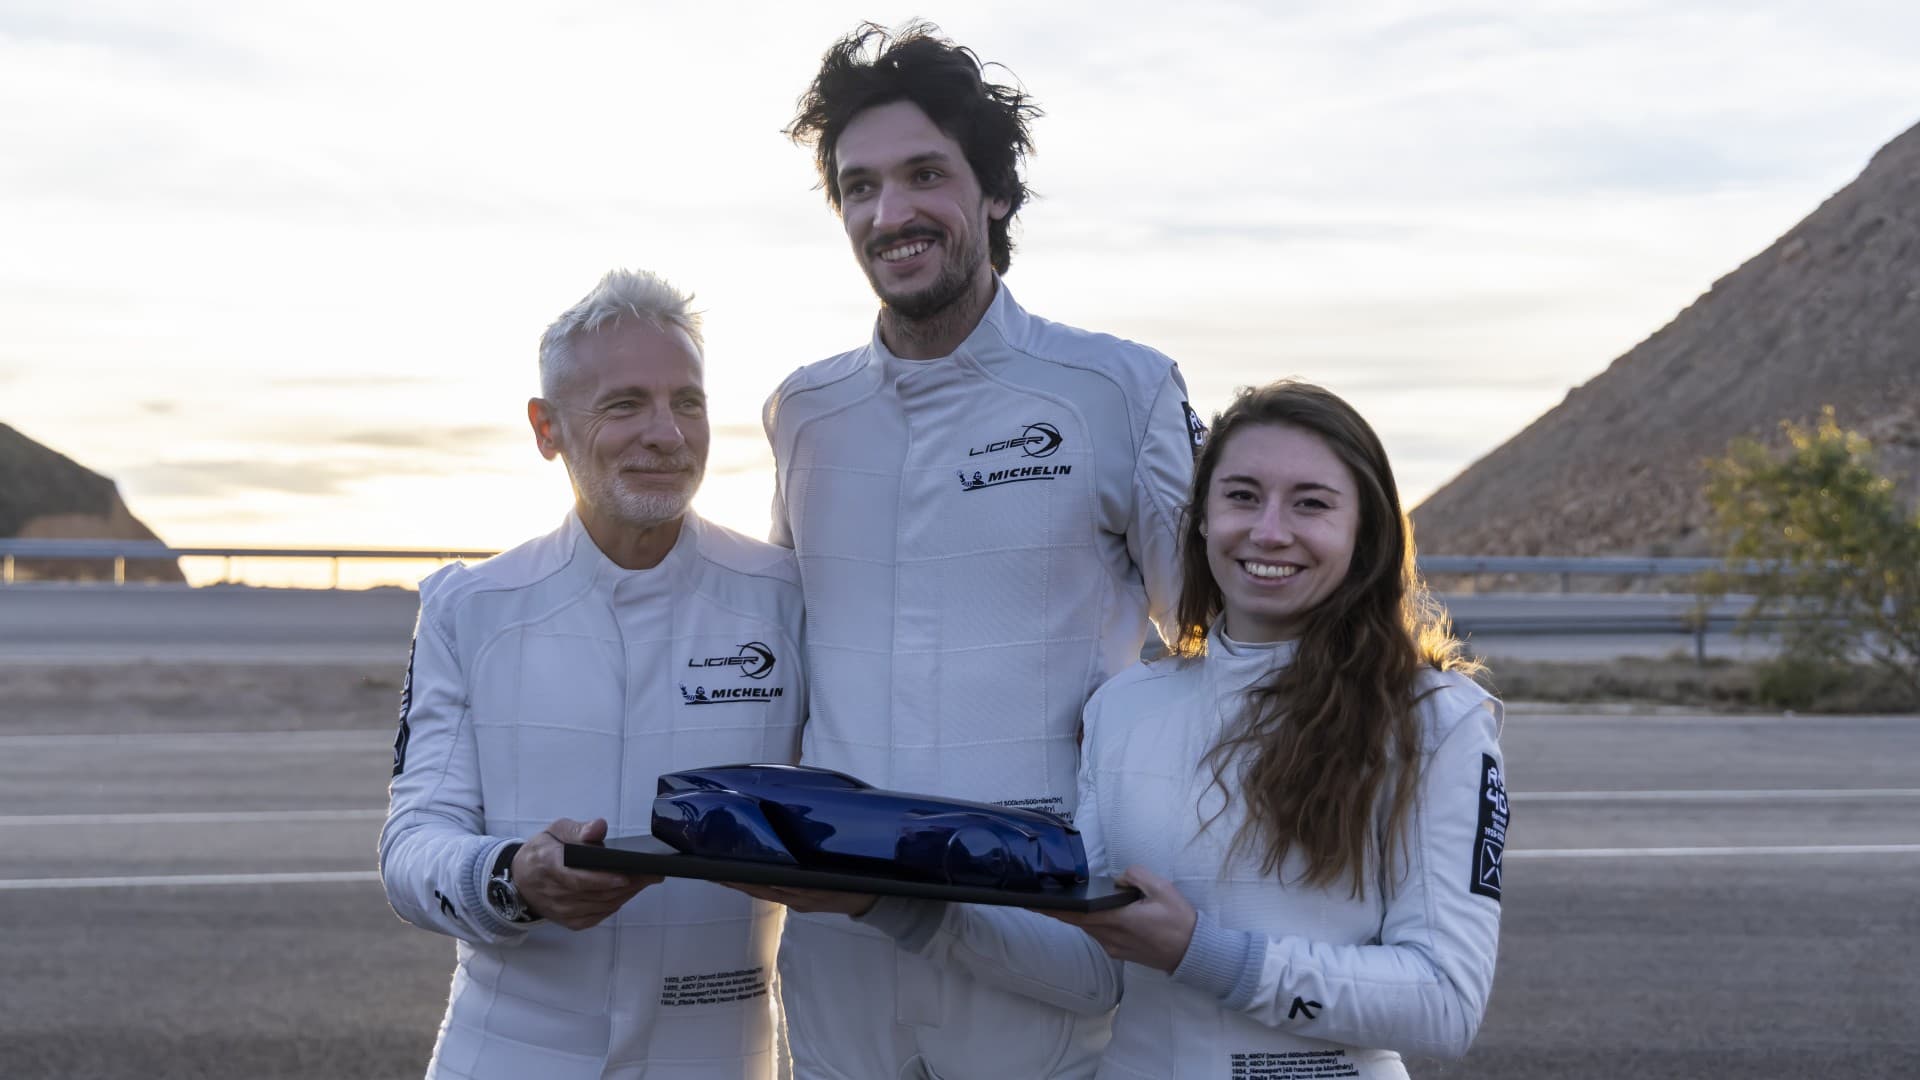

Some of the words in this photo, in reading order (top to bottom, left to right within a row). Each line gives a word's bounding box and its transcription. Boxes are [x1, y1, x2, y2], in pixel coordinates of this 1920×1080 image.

[968, 436, 1044, 456] LIGIER
[988, 465, 1072, 483] MICHELIN
[688, 656, 759, 668] LIGIER
[711, 687, 784, 698] MICHELIN
